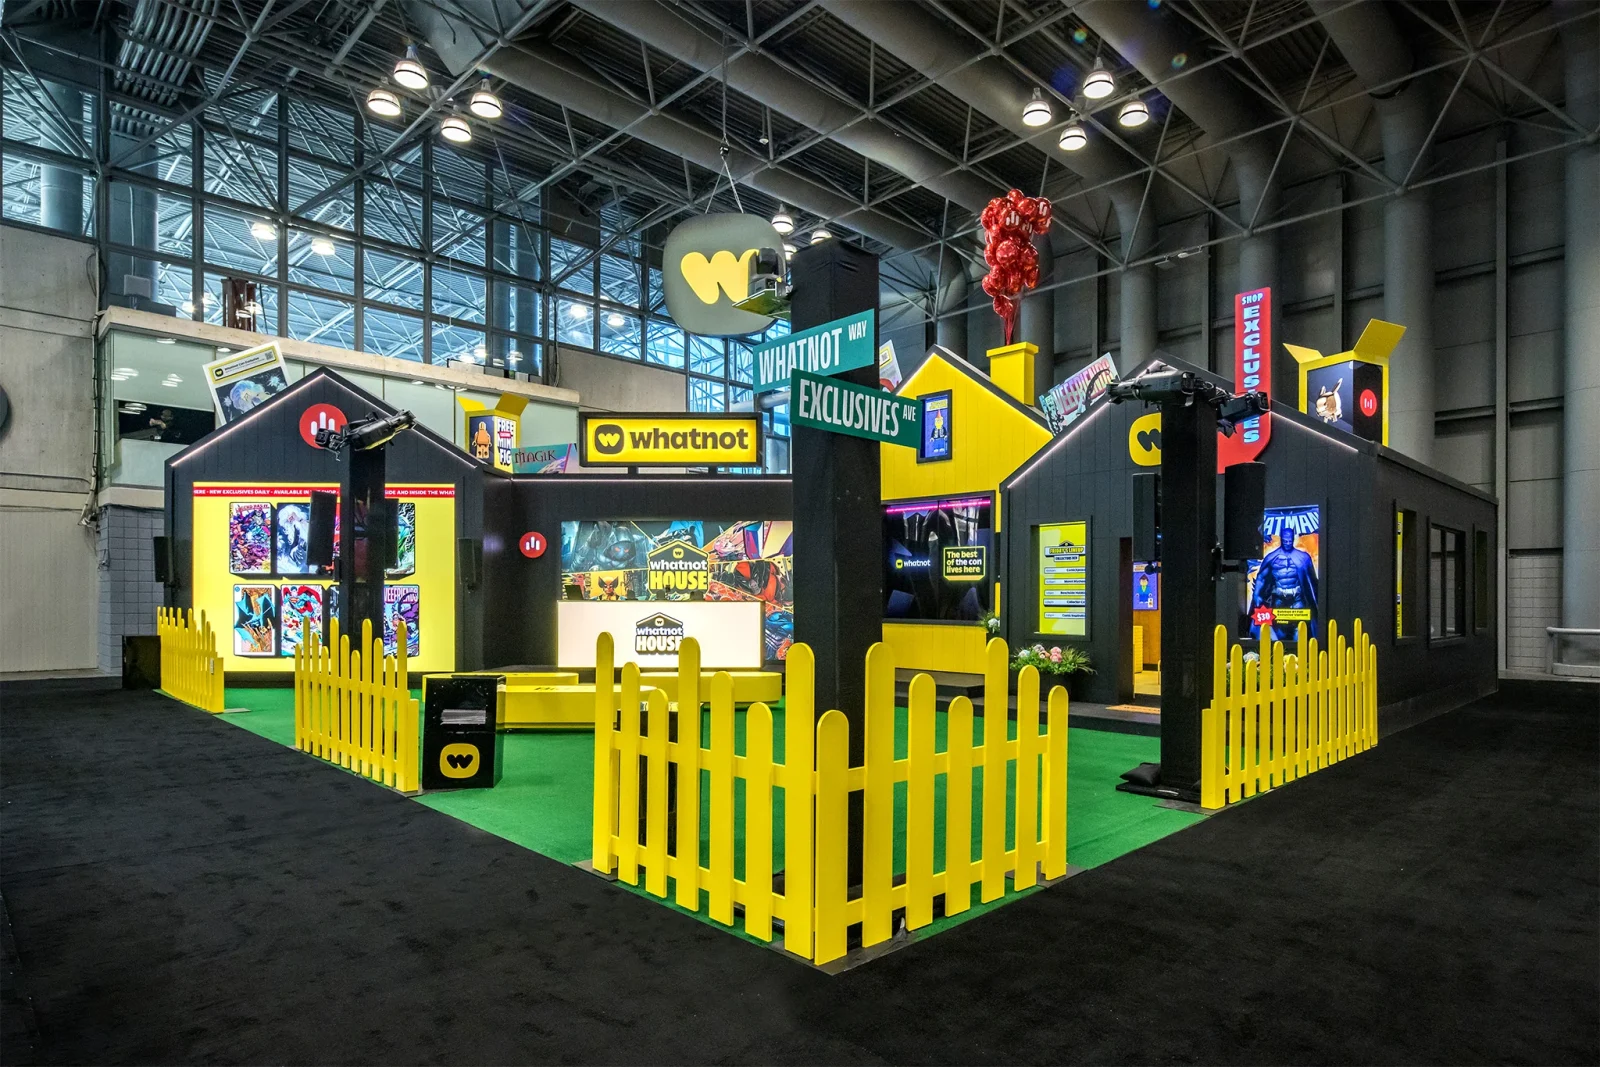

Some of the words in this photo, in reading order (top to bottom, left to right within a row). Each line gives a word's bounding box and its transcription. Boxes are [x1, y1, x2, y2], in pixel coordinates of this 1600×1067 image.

[1242, 293, 1263, 304] SHOP
[759, 327, 843, 386] WHATNOT
[848, 320, 867, 341] WAY
[1243, 304, 1260, 443] EXCLUSES
[799, 378, 900, 437] EXCLUSIVES
[902, 404, 917, 422] AVE
[497, 419, 514, 435] FREE
[630, 428, 749, 450] whatnot
[499, 449, 512, 465] FIG
[515, 449, 557, 465] MAGIK
[1264, 512, 1319, 537] ATMAN
[650, 559, 707, 571] whatnot
[650, 571, 707, 590] HOUSE
[1257, 612, 1271, 622] $30
[637, 627, 683, 635] whatnot
